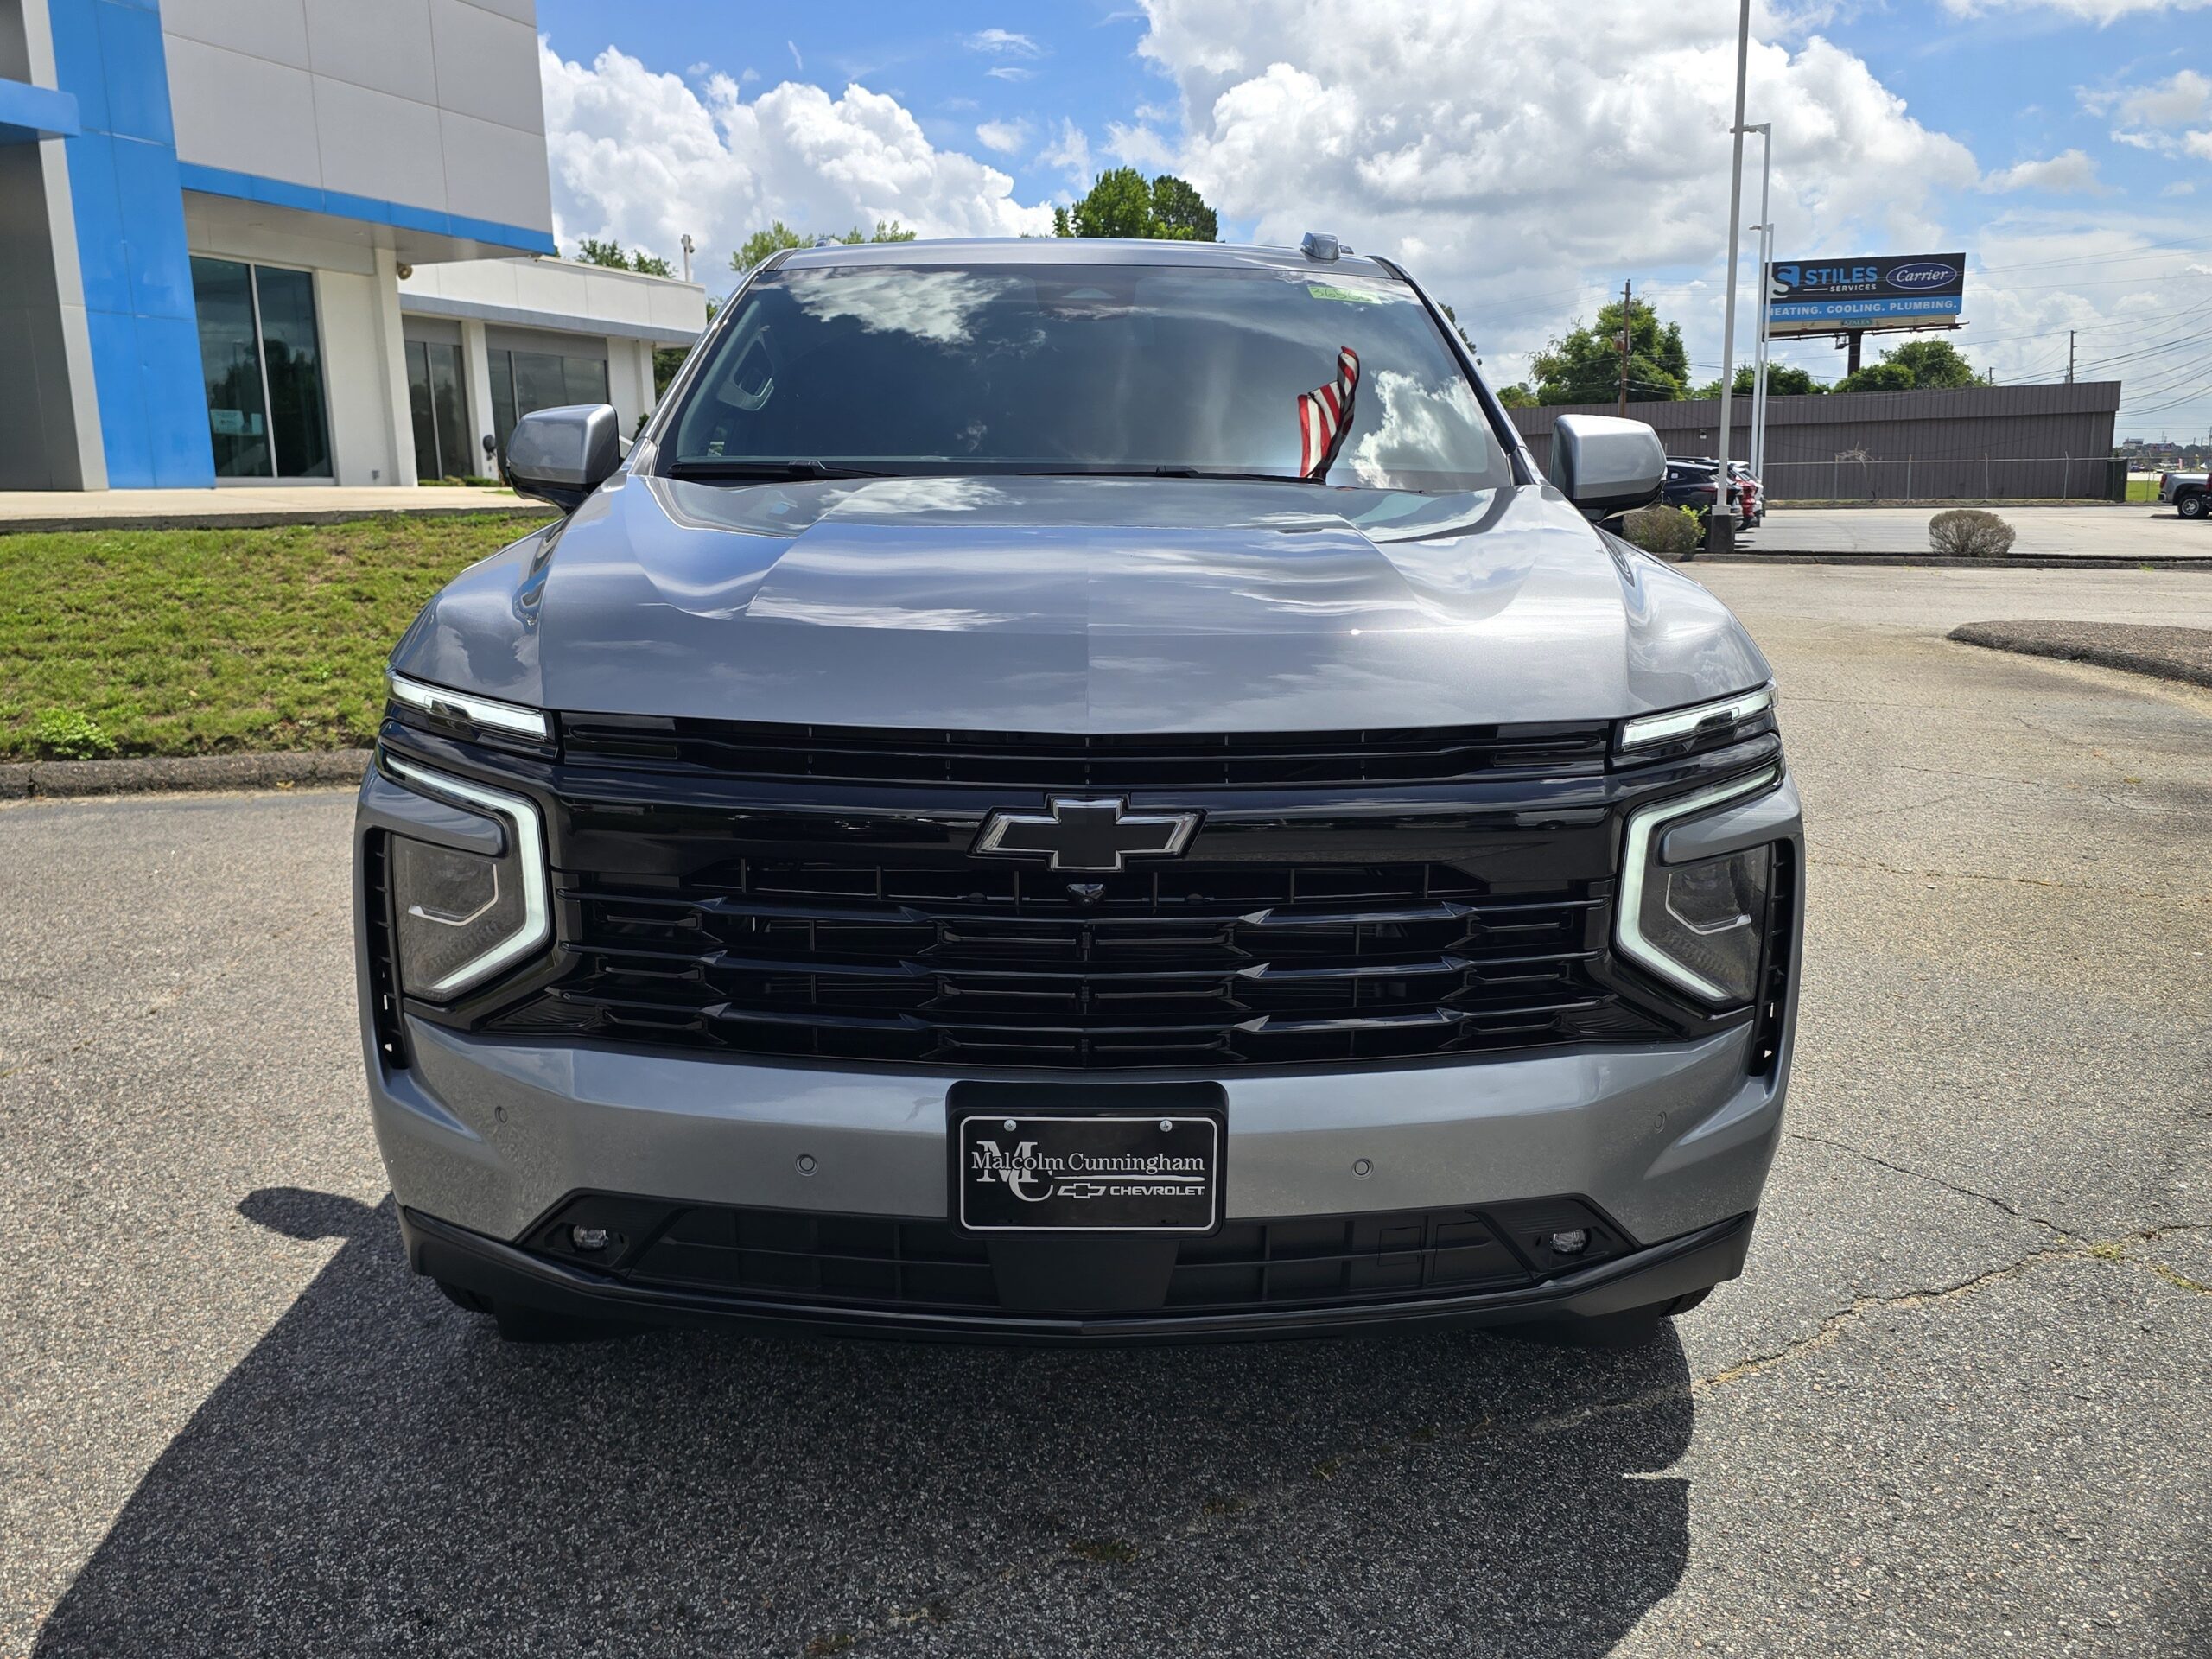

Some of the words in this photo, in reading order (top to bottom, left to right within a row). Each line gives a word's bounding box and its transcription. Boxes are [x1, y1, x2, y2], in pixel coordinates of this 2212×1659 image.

[1805, 267, 1878, 285] STILES
[1896, 269, 1948, 283] Carrier
[1829, 283, 1877, 292] SERVICES
[1827, 303, 1885, 314] COOLING.
[1890, 300, 1957, 311] PLUMBING.
[971, 1151, 1065, 1171] Malcolm
[1068, 1152, 1205, 1175] Cunningham
[1110, 1185, 1205, 1196] CHEVROLET
